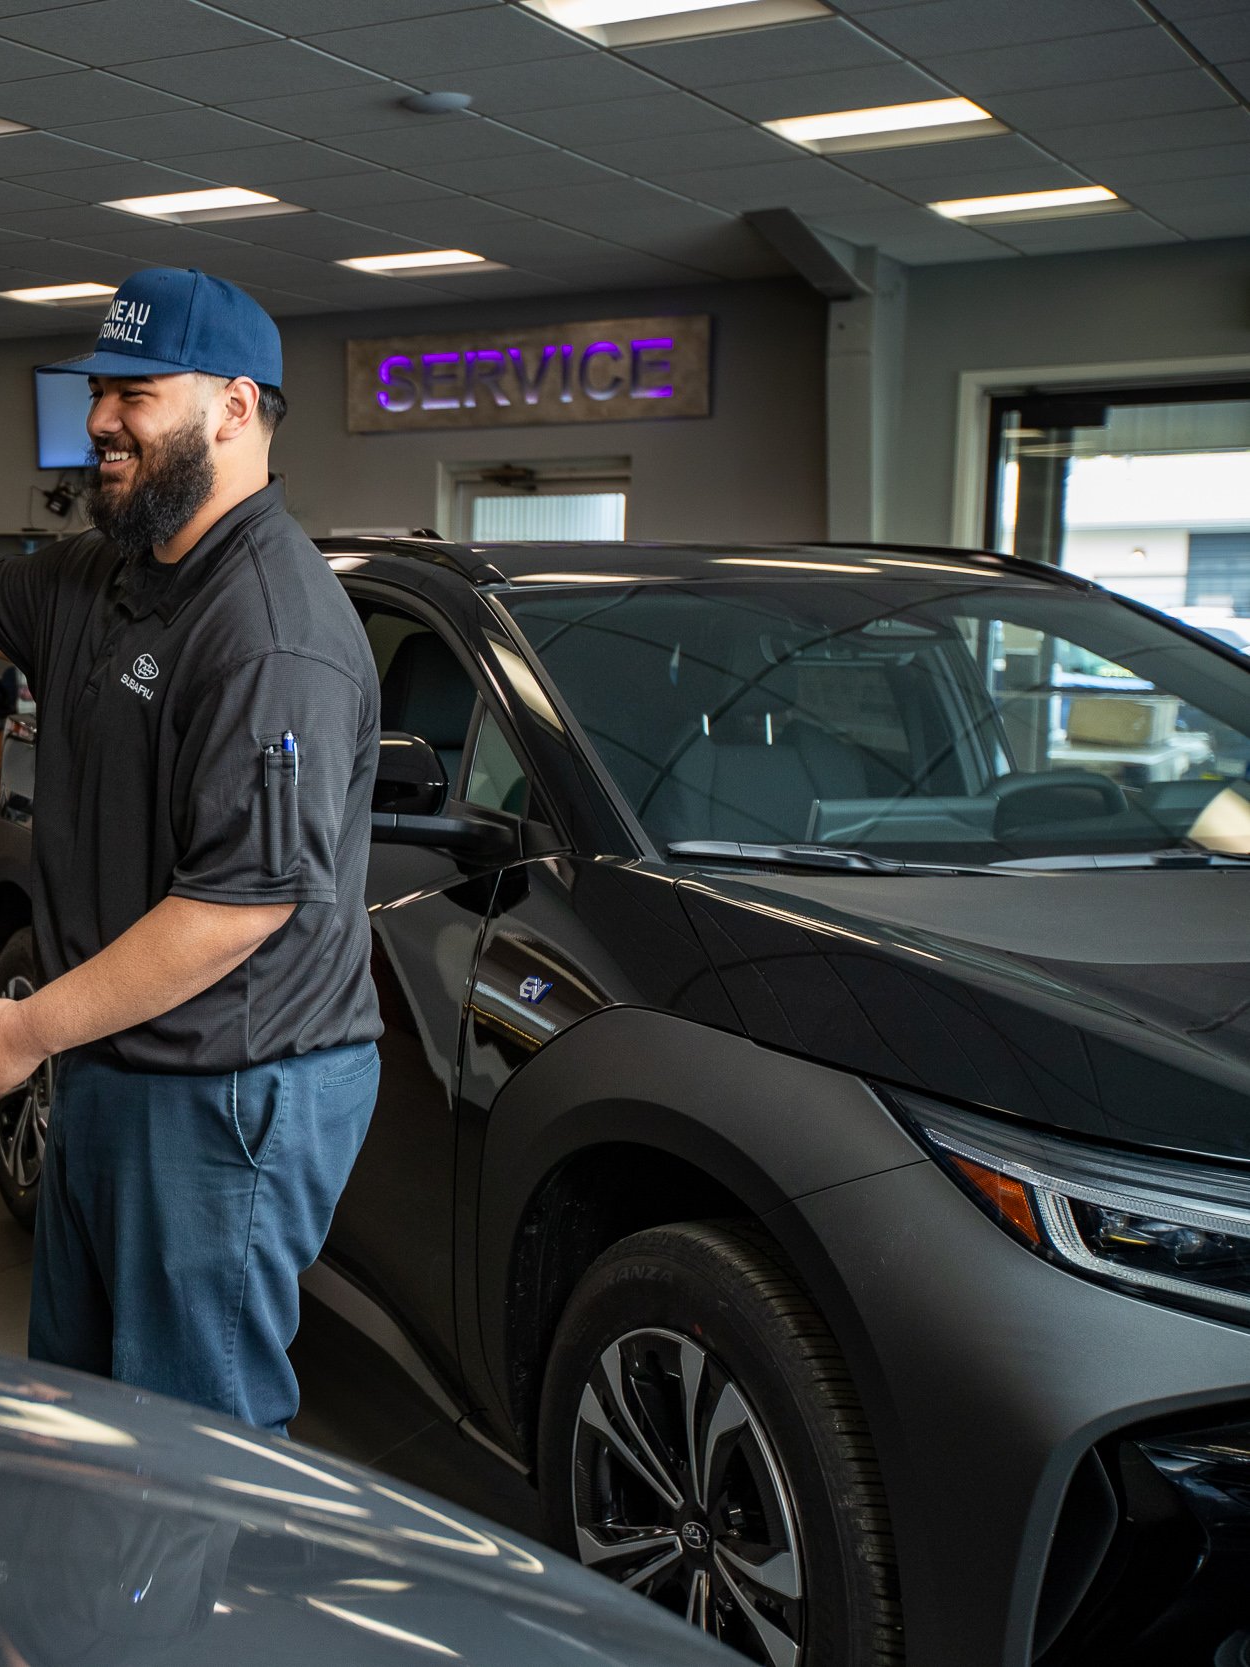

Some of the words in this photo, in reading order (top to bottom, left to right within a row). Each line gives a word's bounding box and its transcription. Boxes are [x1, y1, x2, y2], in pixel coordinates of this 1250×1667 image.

[104, 300, 151, 326] NEAU
[376, 338, 673, 413] SERVICE
[120, 673, 154, 701] SUBARU
[519, 976, 554, 1005] EV
